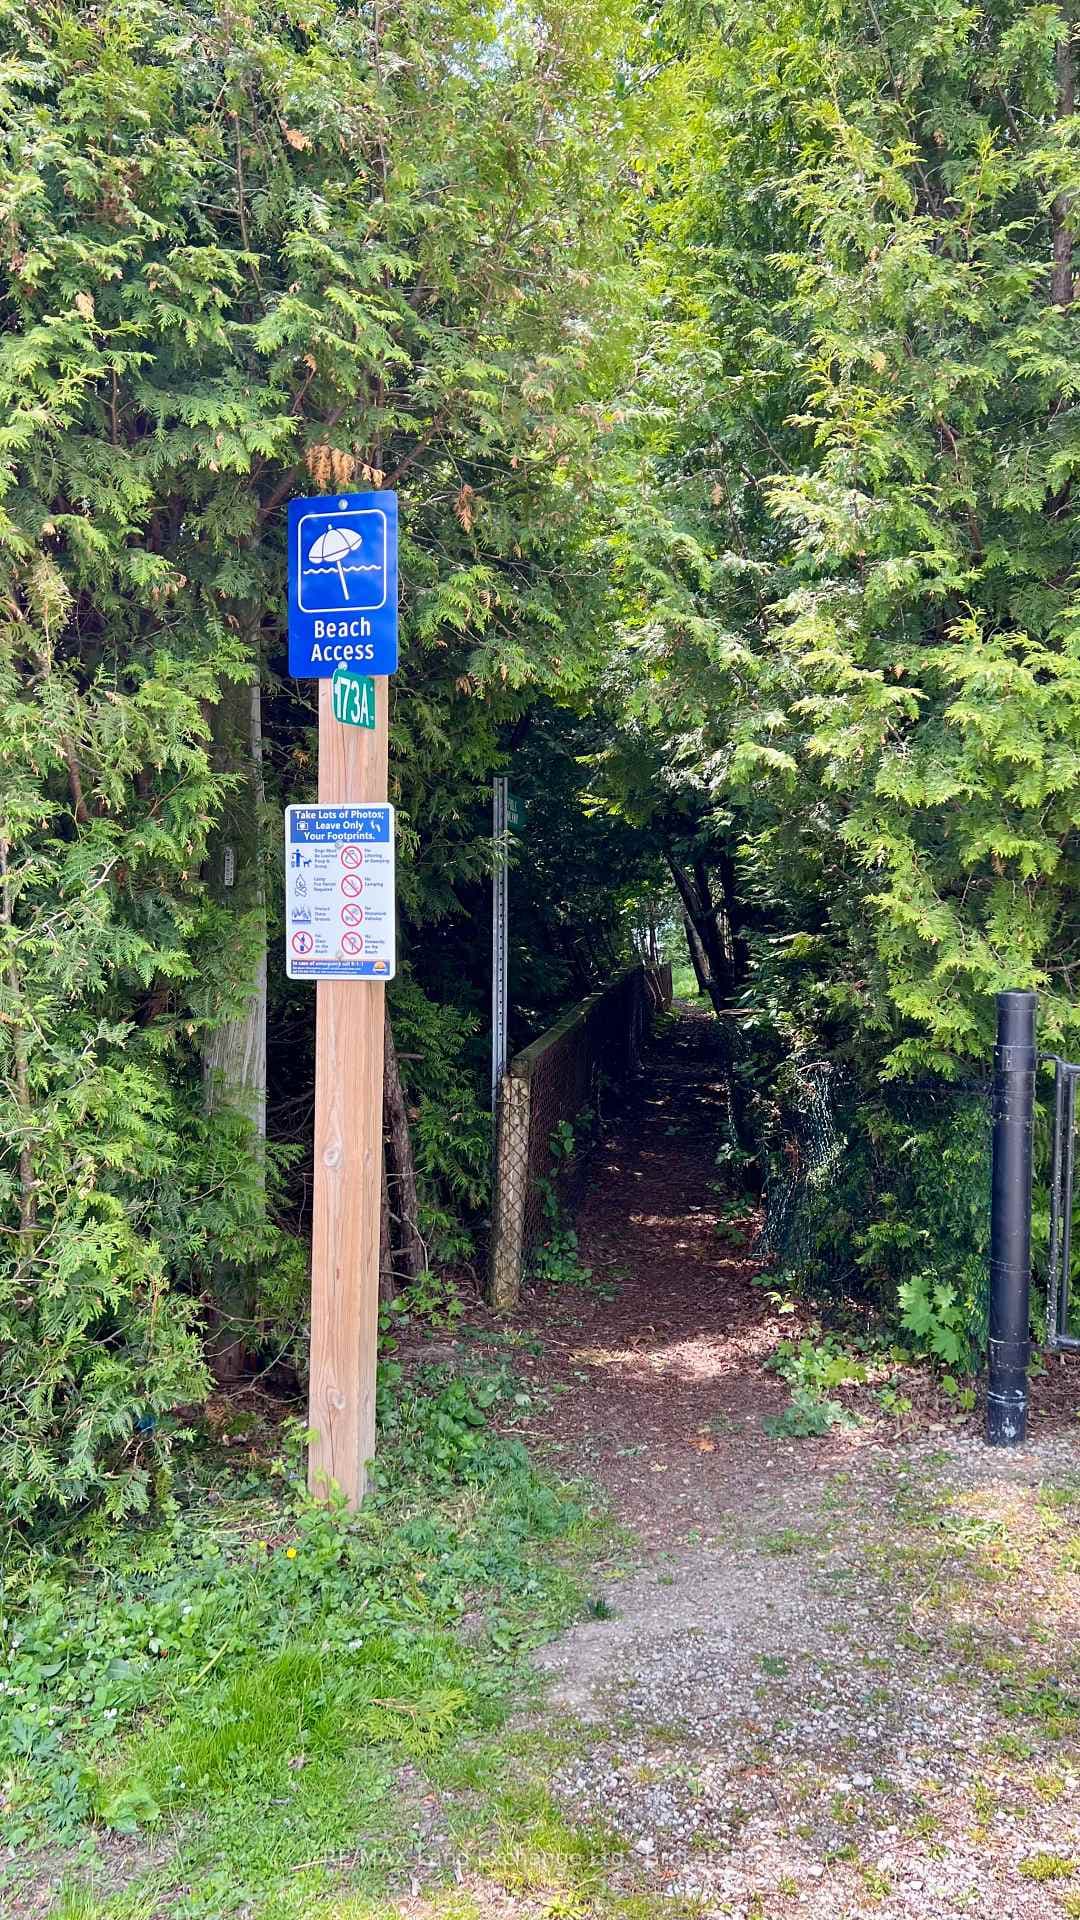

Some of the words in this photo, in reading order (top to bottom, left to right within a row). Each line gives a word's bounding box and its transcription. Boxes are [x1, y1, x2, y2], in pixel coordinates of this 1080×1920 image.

[314, 616, 371, 638] Beach
[310, 643, 374, 662] Access
[334, 676, 370, 726] 173A
[295, 811, 316, 819] Take
[318, 810, 337, 819] Lots
[339, 810, 348, 819] of
[315, 821, 341, 830] Leave
[343, 821, 364, 831] Only
[304, 832, 325, 840] Your
[327, 832, 376, 842] Footprints.
